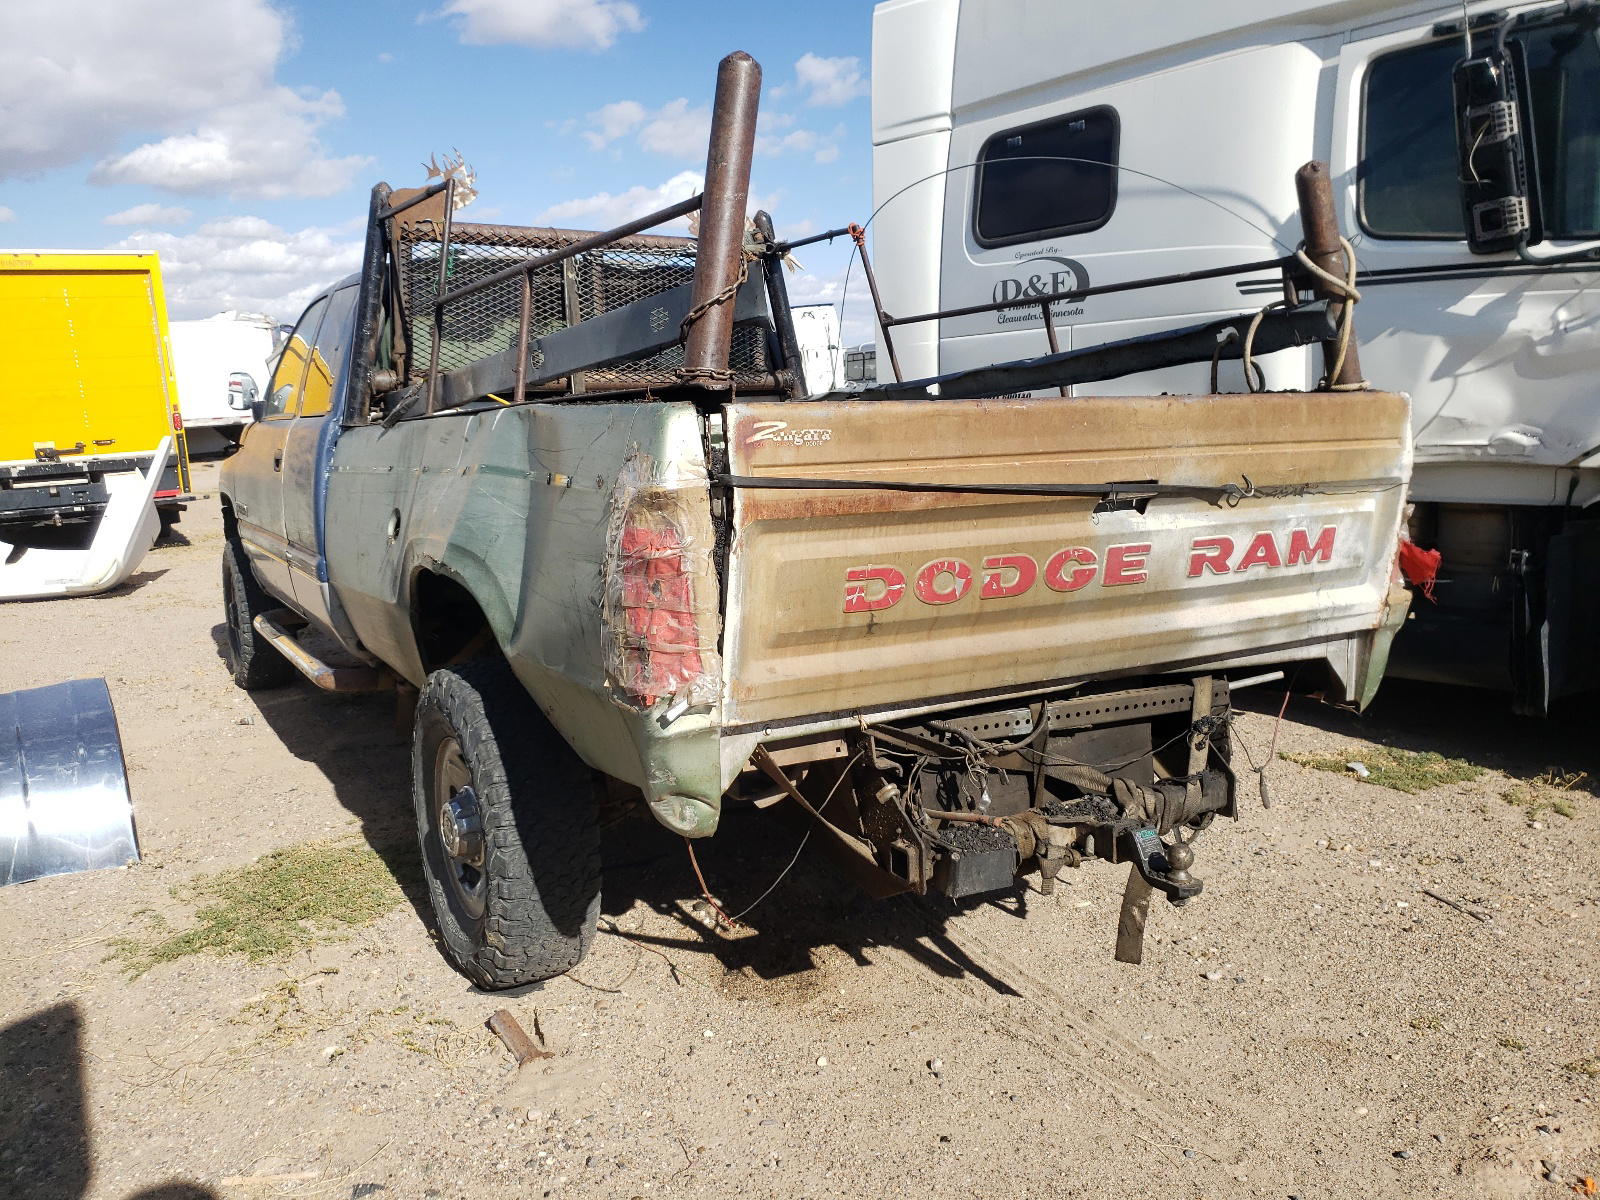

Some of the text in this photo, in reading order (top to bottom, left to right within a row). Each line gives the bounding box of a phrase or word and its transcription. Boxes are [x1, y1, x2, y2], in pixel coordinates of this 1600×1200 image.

[1000, 270, 1072, 302] D&E
[746, 421, 831, 445] Zangara
[843, 525, 1337, 613] DODGE RAM
